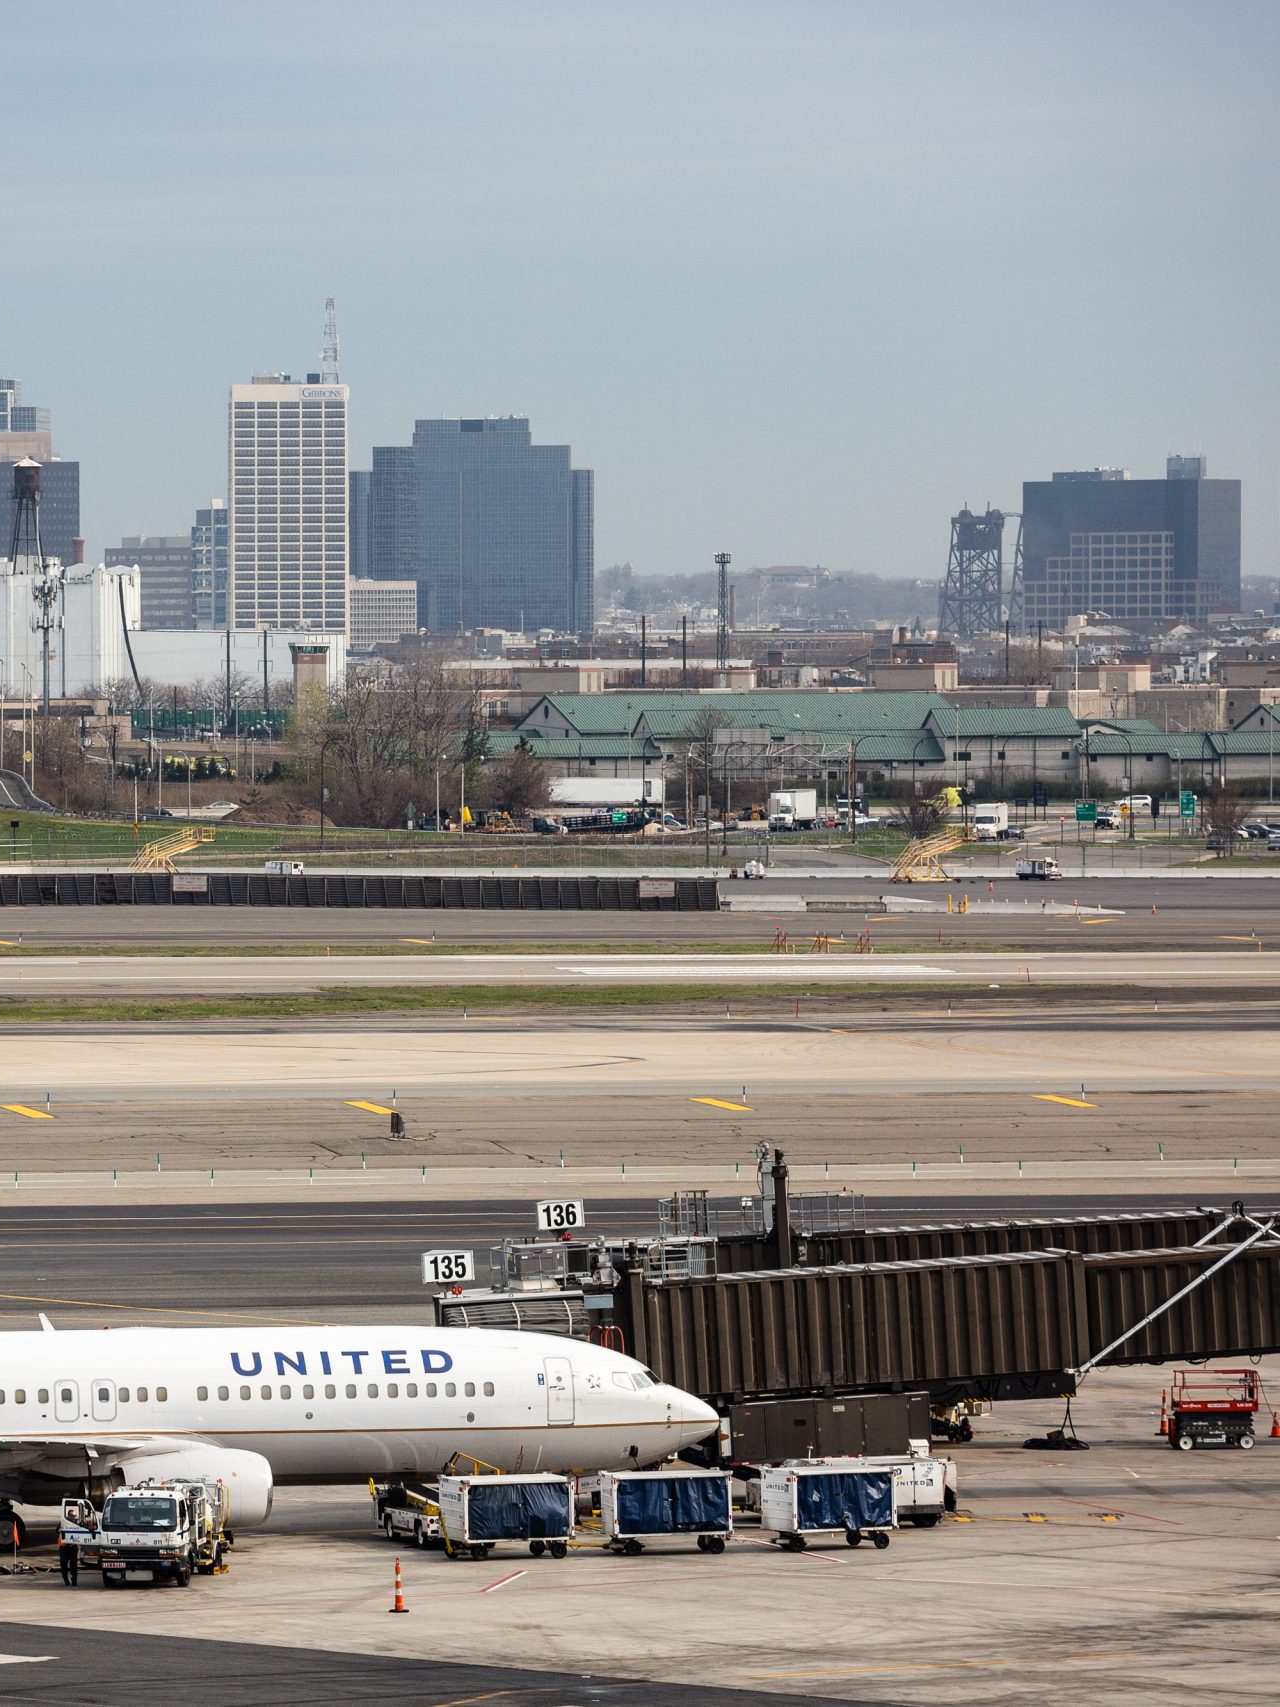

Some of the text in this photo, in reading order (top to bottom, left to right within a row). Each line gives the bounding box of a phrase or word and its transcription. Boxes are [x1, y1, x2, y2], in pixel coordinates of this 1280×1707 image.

[302, 388, 341, 398] GIBBONS
[542, 1203, 578, 1228] 136
[429, 1255, 467, 1280] 135
[230, 1349, 453, 1377] UNITED
